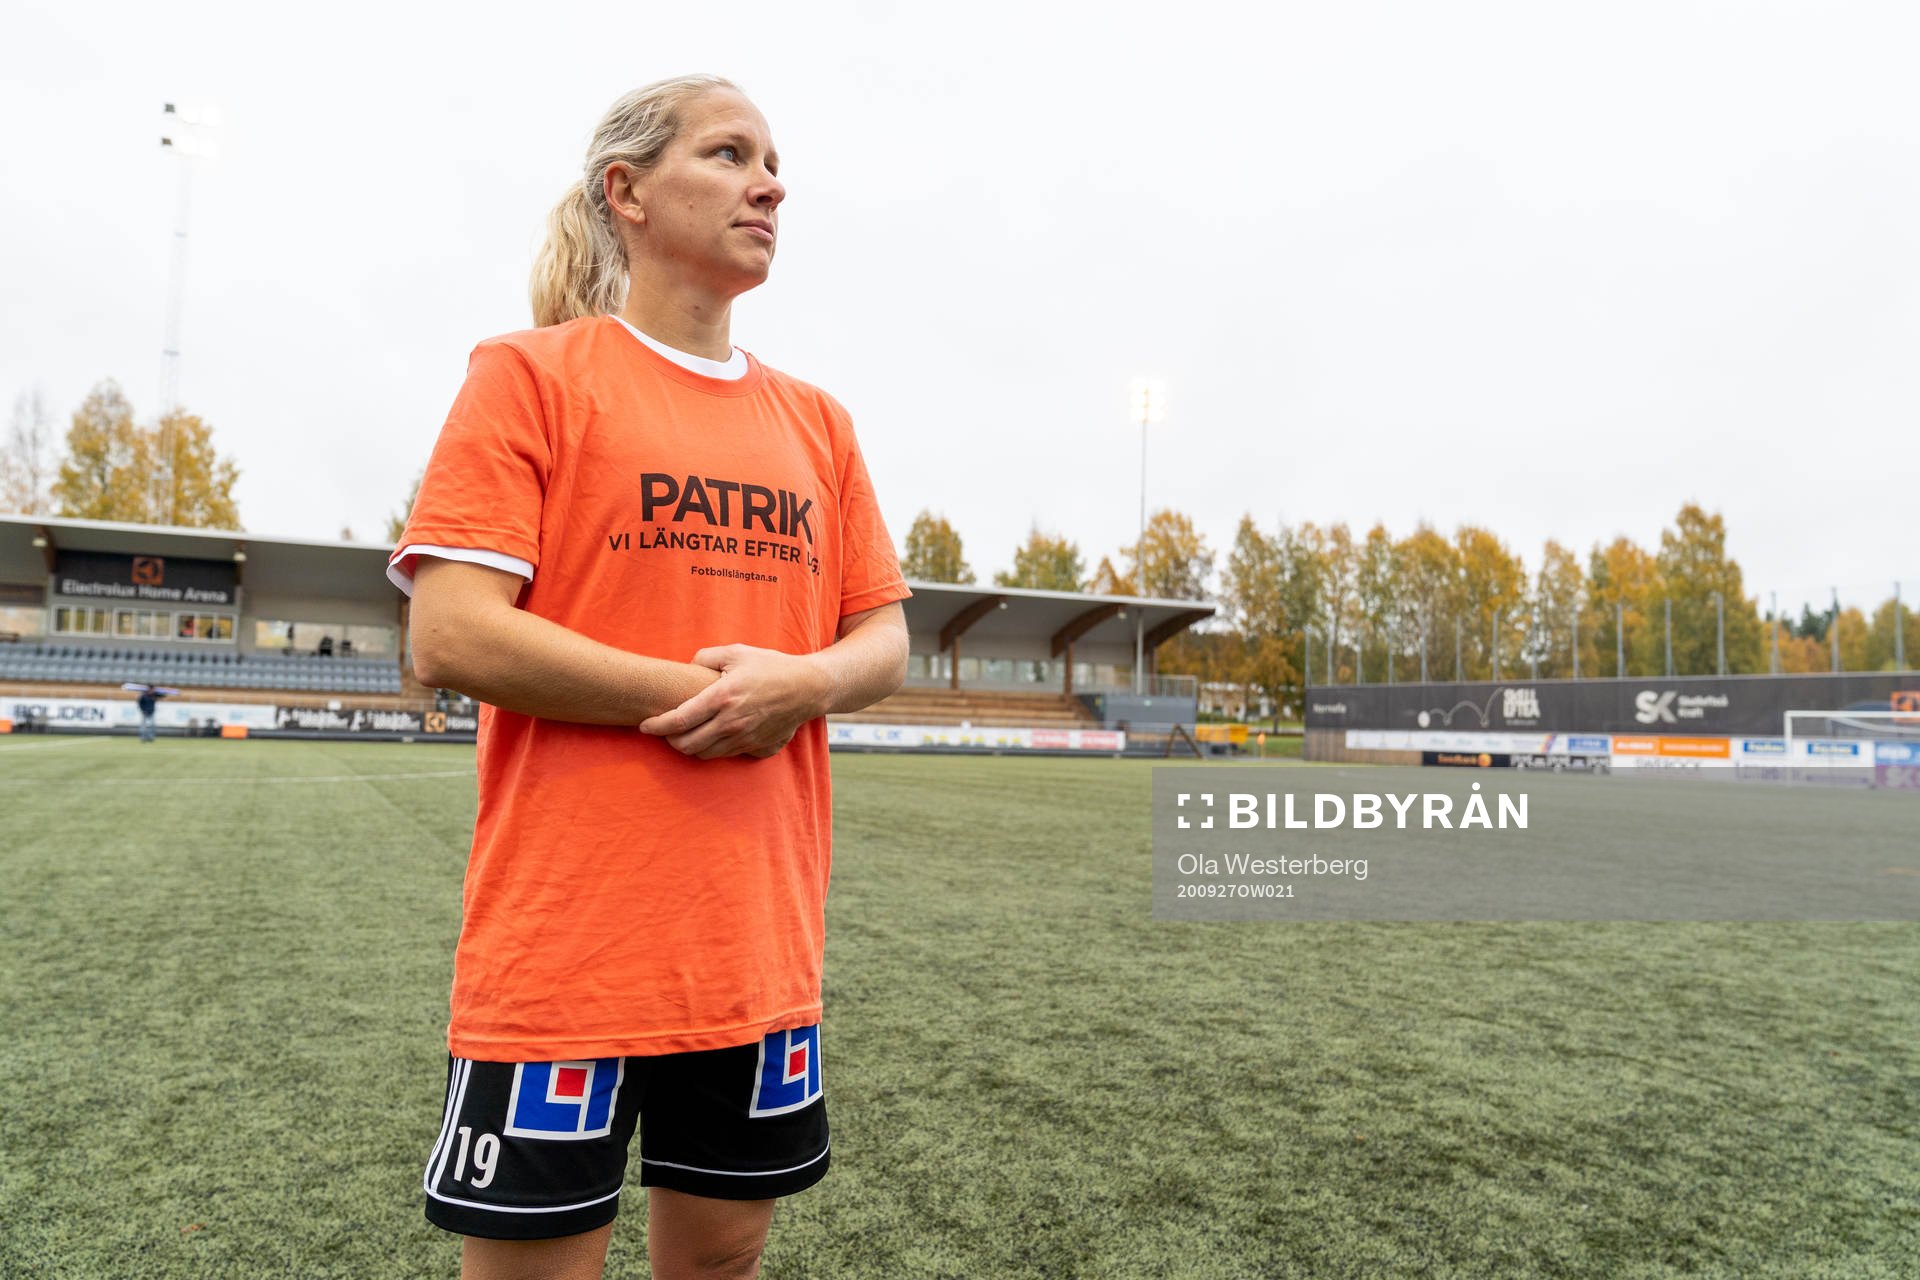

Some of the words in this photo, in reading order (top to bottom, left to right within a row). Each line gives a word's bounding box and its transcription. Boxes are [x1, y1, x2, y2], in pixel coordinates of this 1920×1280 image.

[640, 473, 813, 545] PATRIK
[608, 533, 630, 551] VI
[639, 527, 738, 555] LÄNGTAR
[744, 540, 801, 564] EFTER
[691, 566, 778, 583] Fotbollslängtan.se
[454, 1126, 501, 1189] 19
